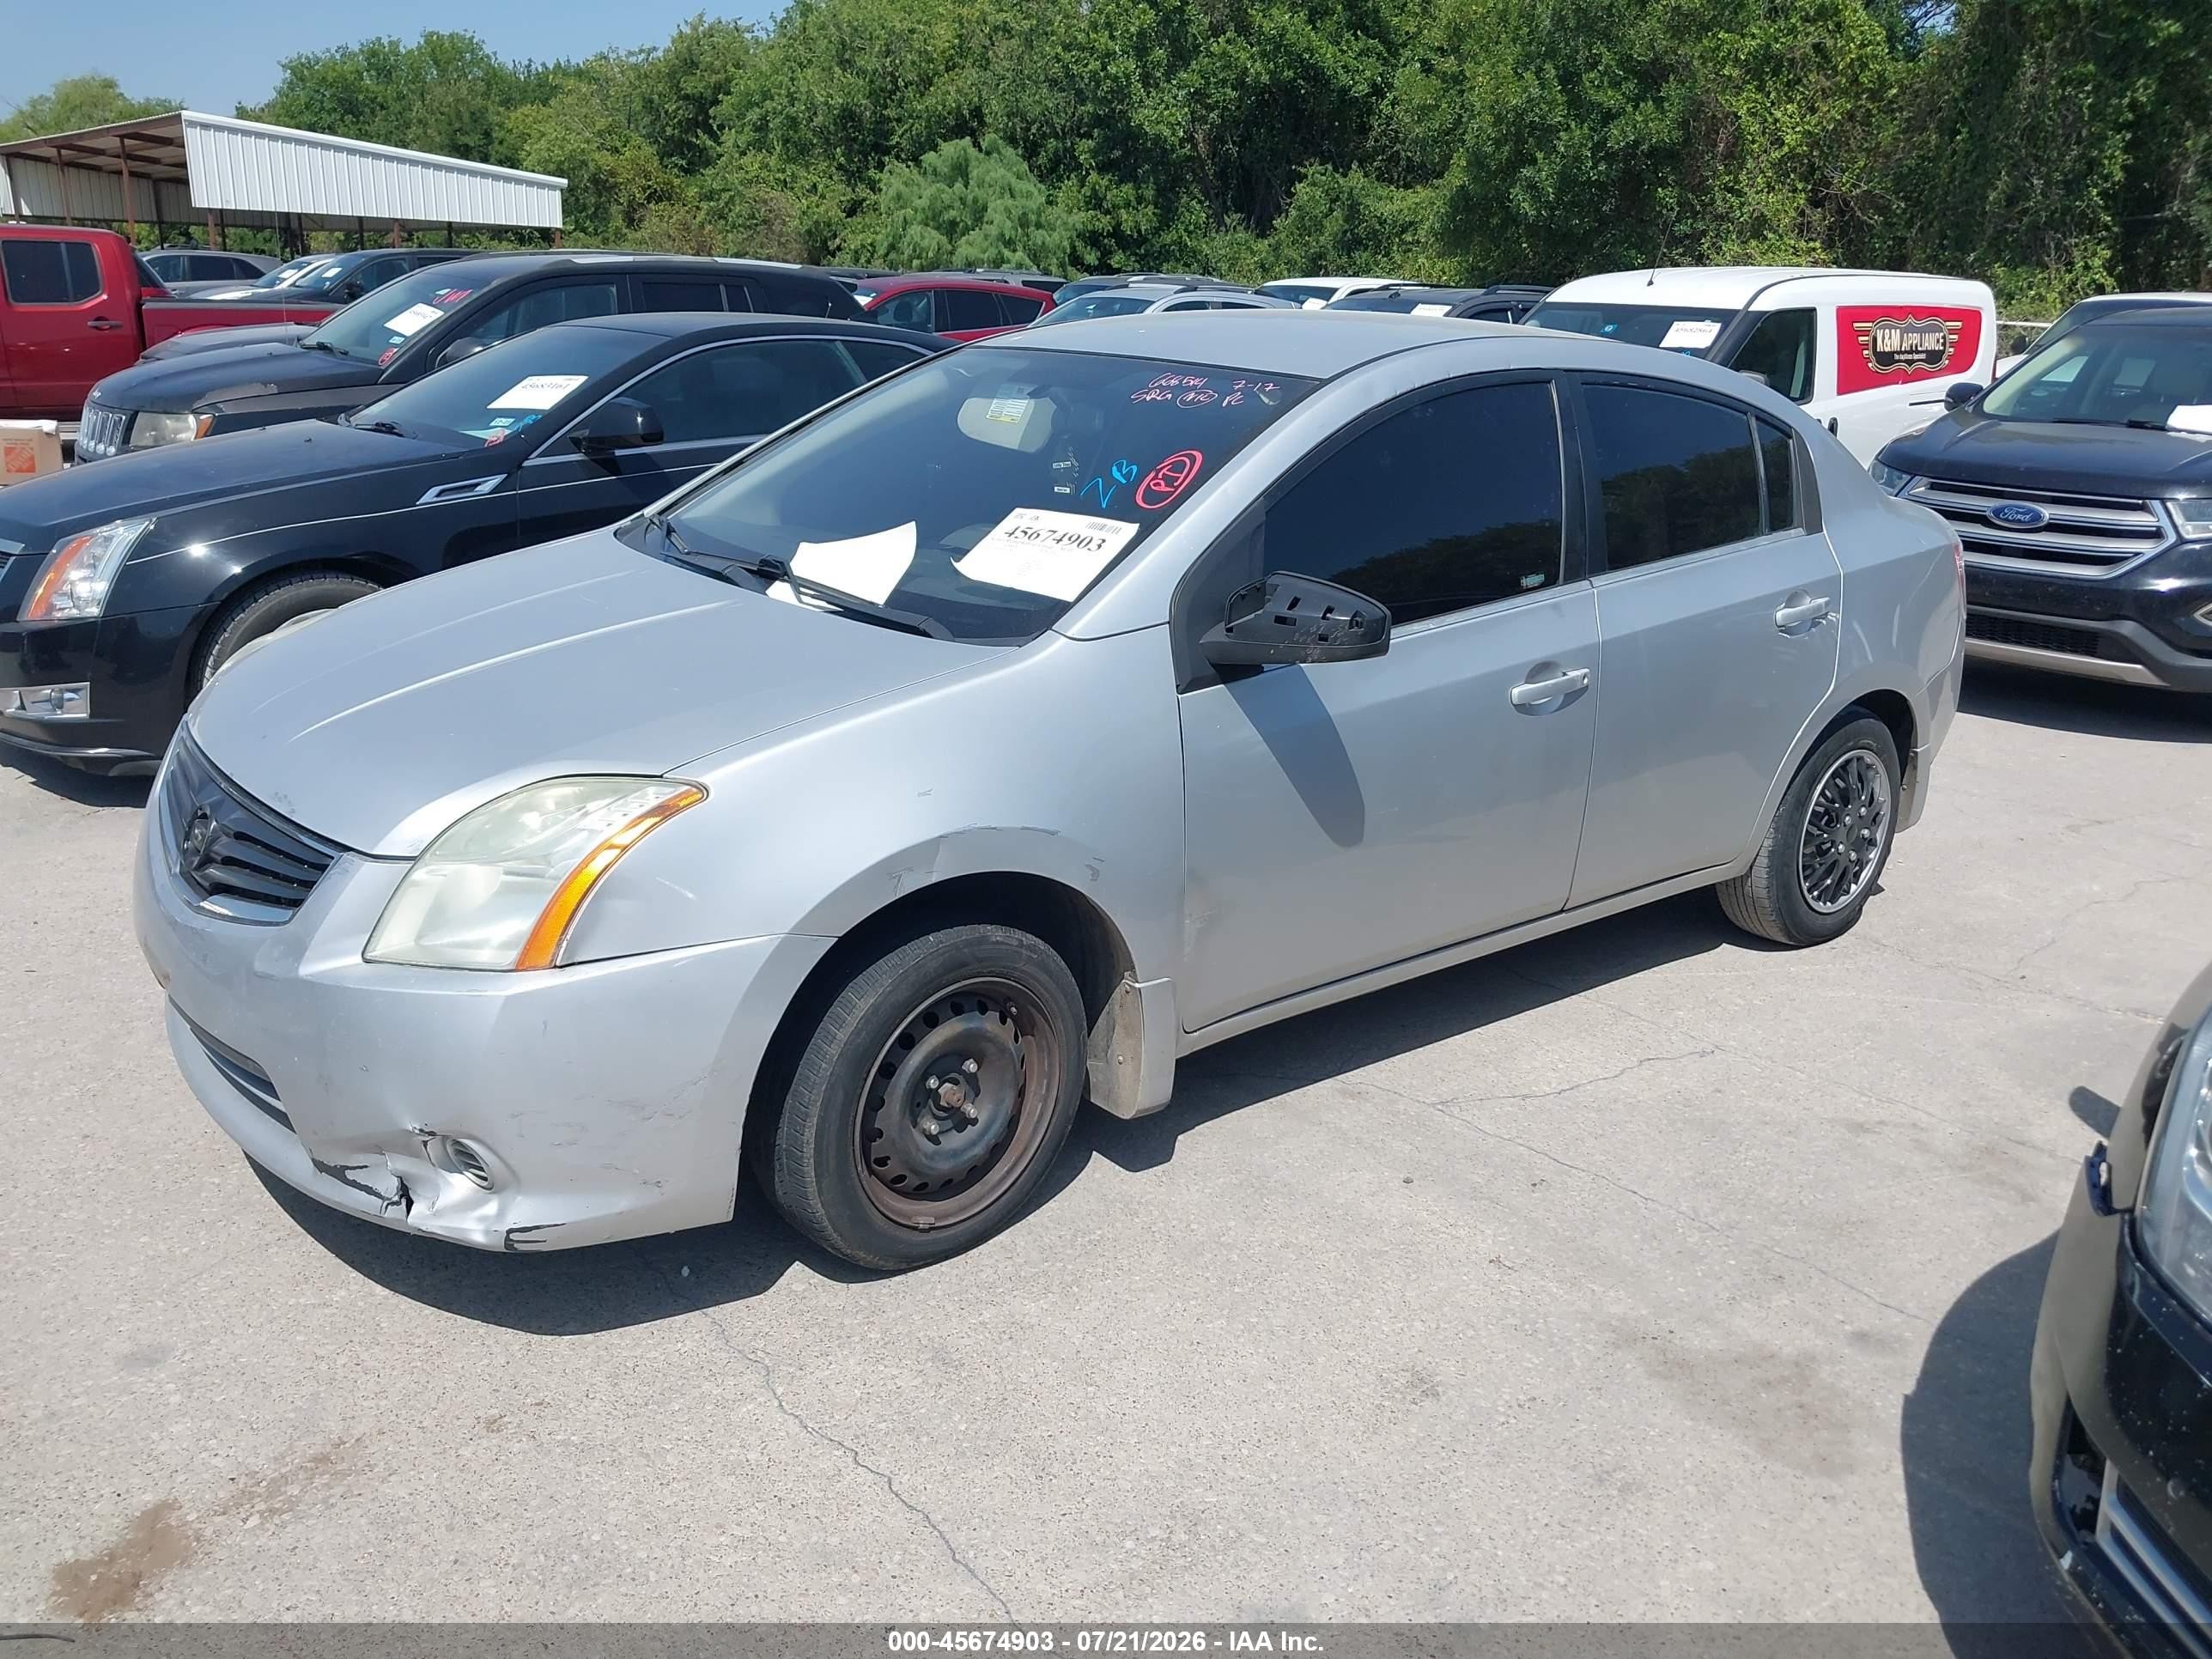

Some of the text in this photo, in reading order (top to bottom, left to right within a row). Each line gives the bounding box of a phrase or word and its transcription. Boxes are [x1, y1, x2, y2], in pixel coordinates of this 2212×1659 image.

[1876, 328, 1945, 352] K&M APPLIANCE
[1999, 507, 2034, 522] Ford
[1004, 525, 1107, 552] 45674903
